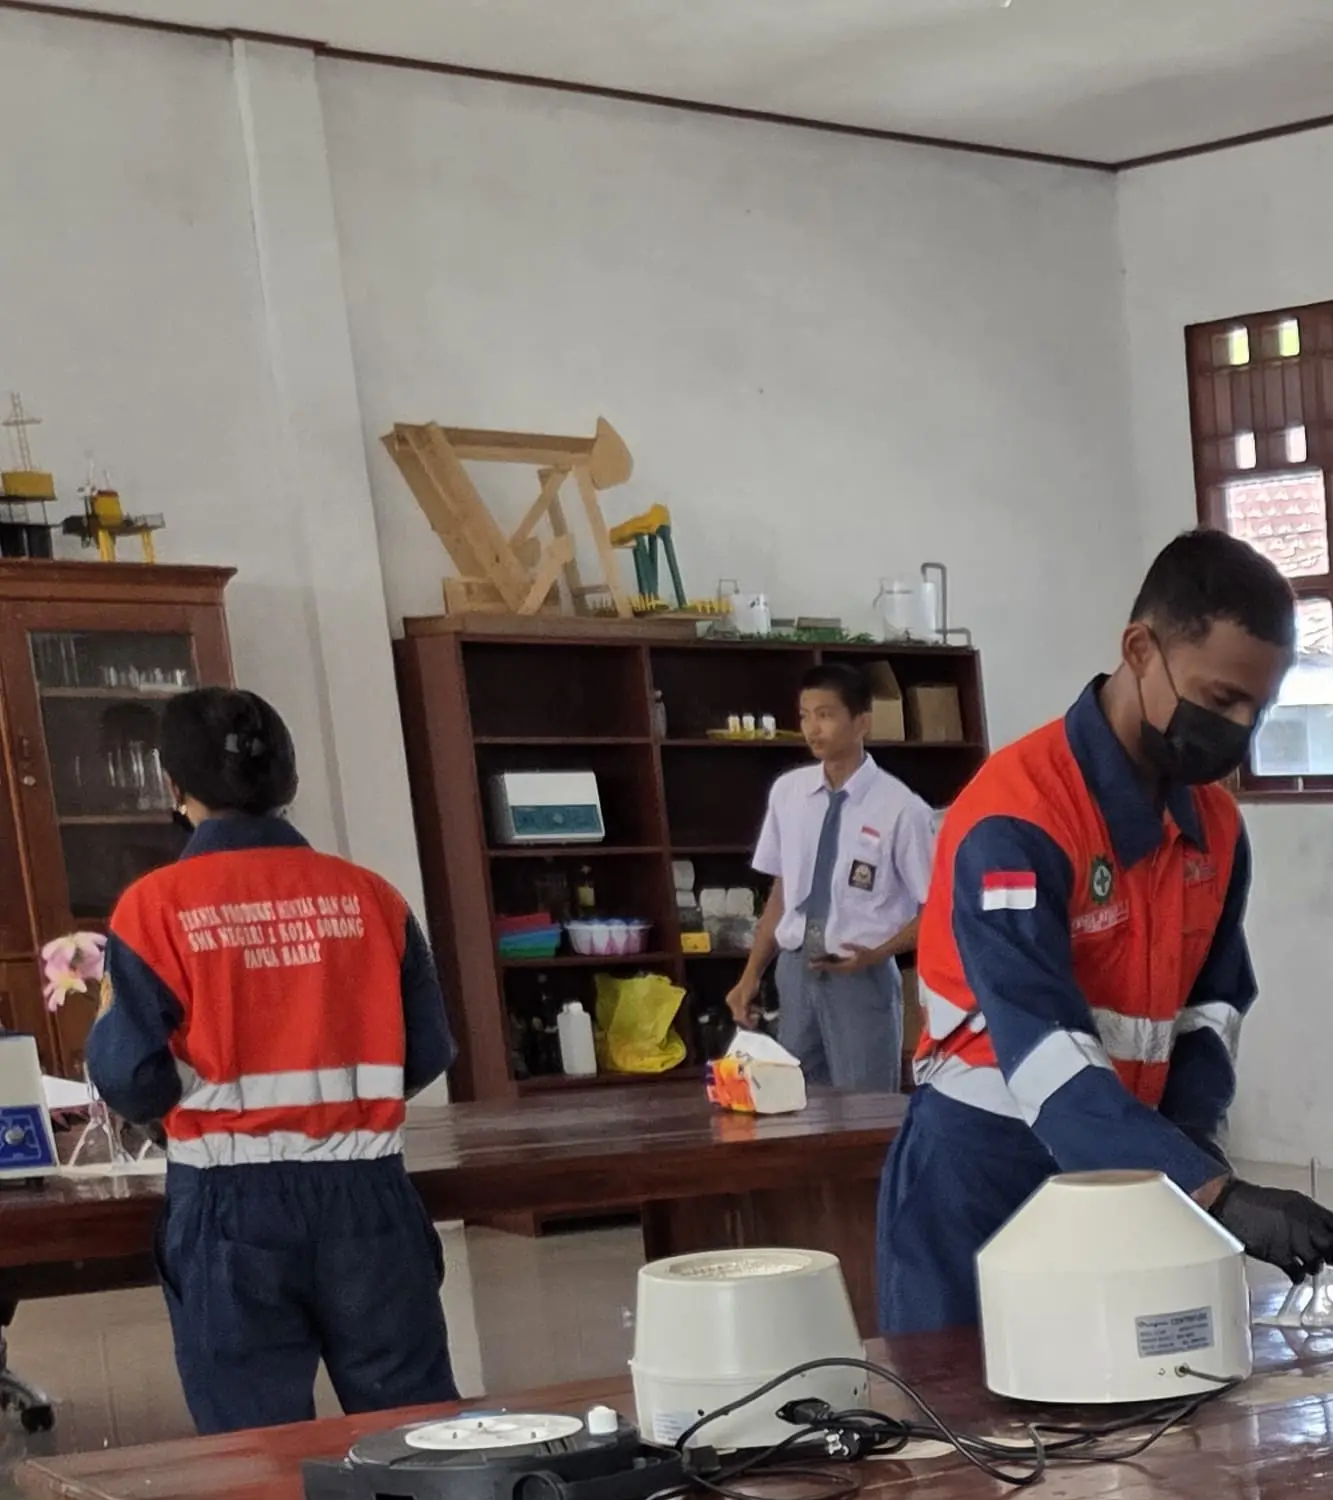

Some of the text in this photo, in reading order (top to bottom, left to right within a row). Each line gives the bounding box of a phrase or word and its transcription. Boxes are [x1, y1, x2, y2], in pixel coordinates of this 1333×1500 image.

[188, 930, 218, 952] SMK
[278, 920, 315, 943] KOTA
[244, 941, 321, 969] PAPUA BARAT
